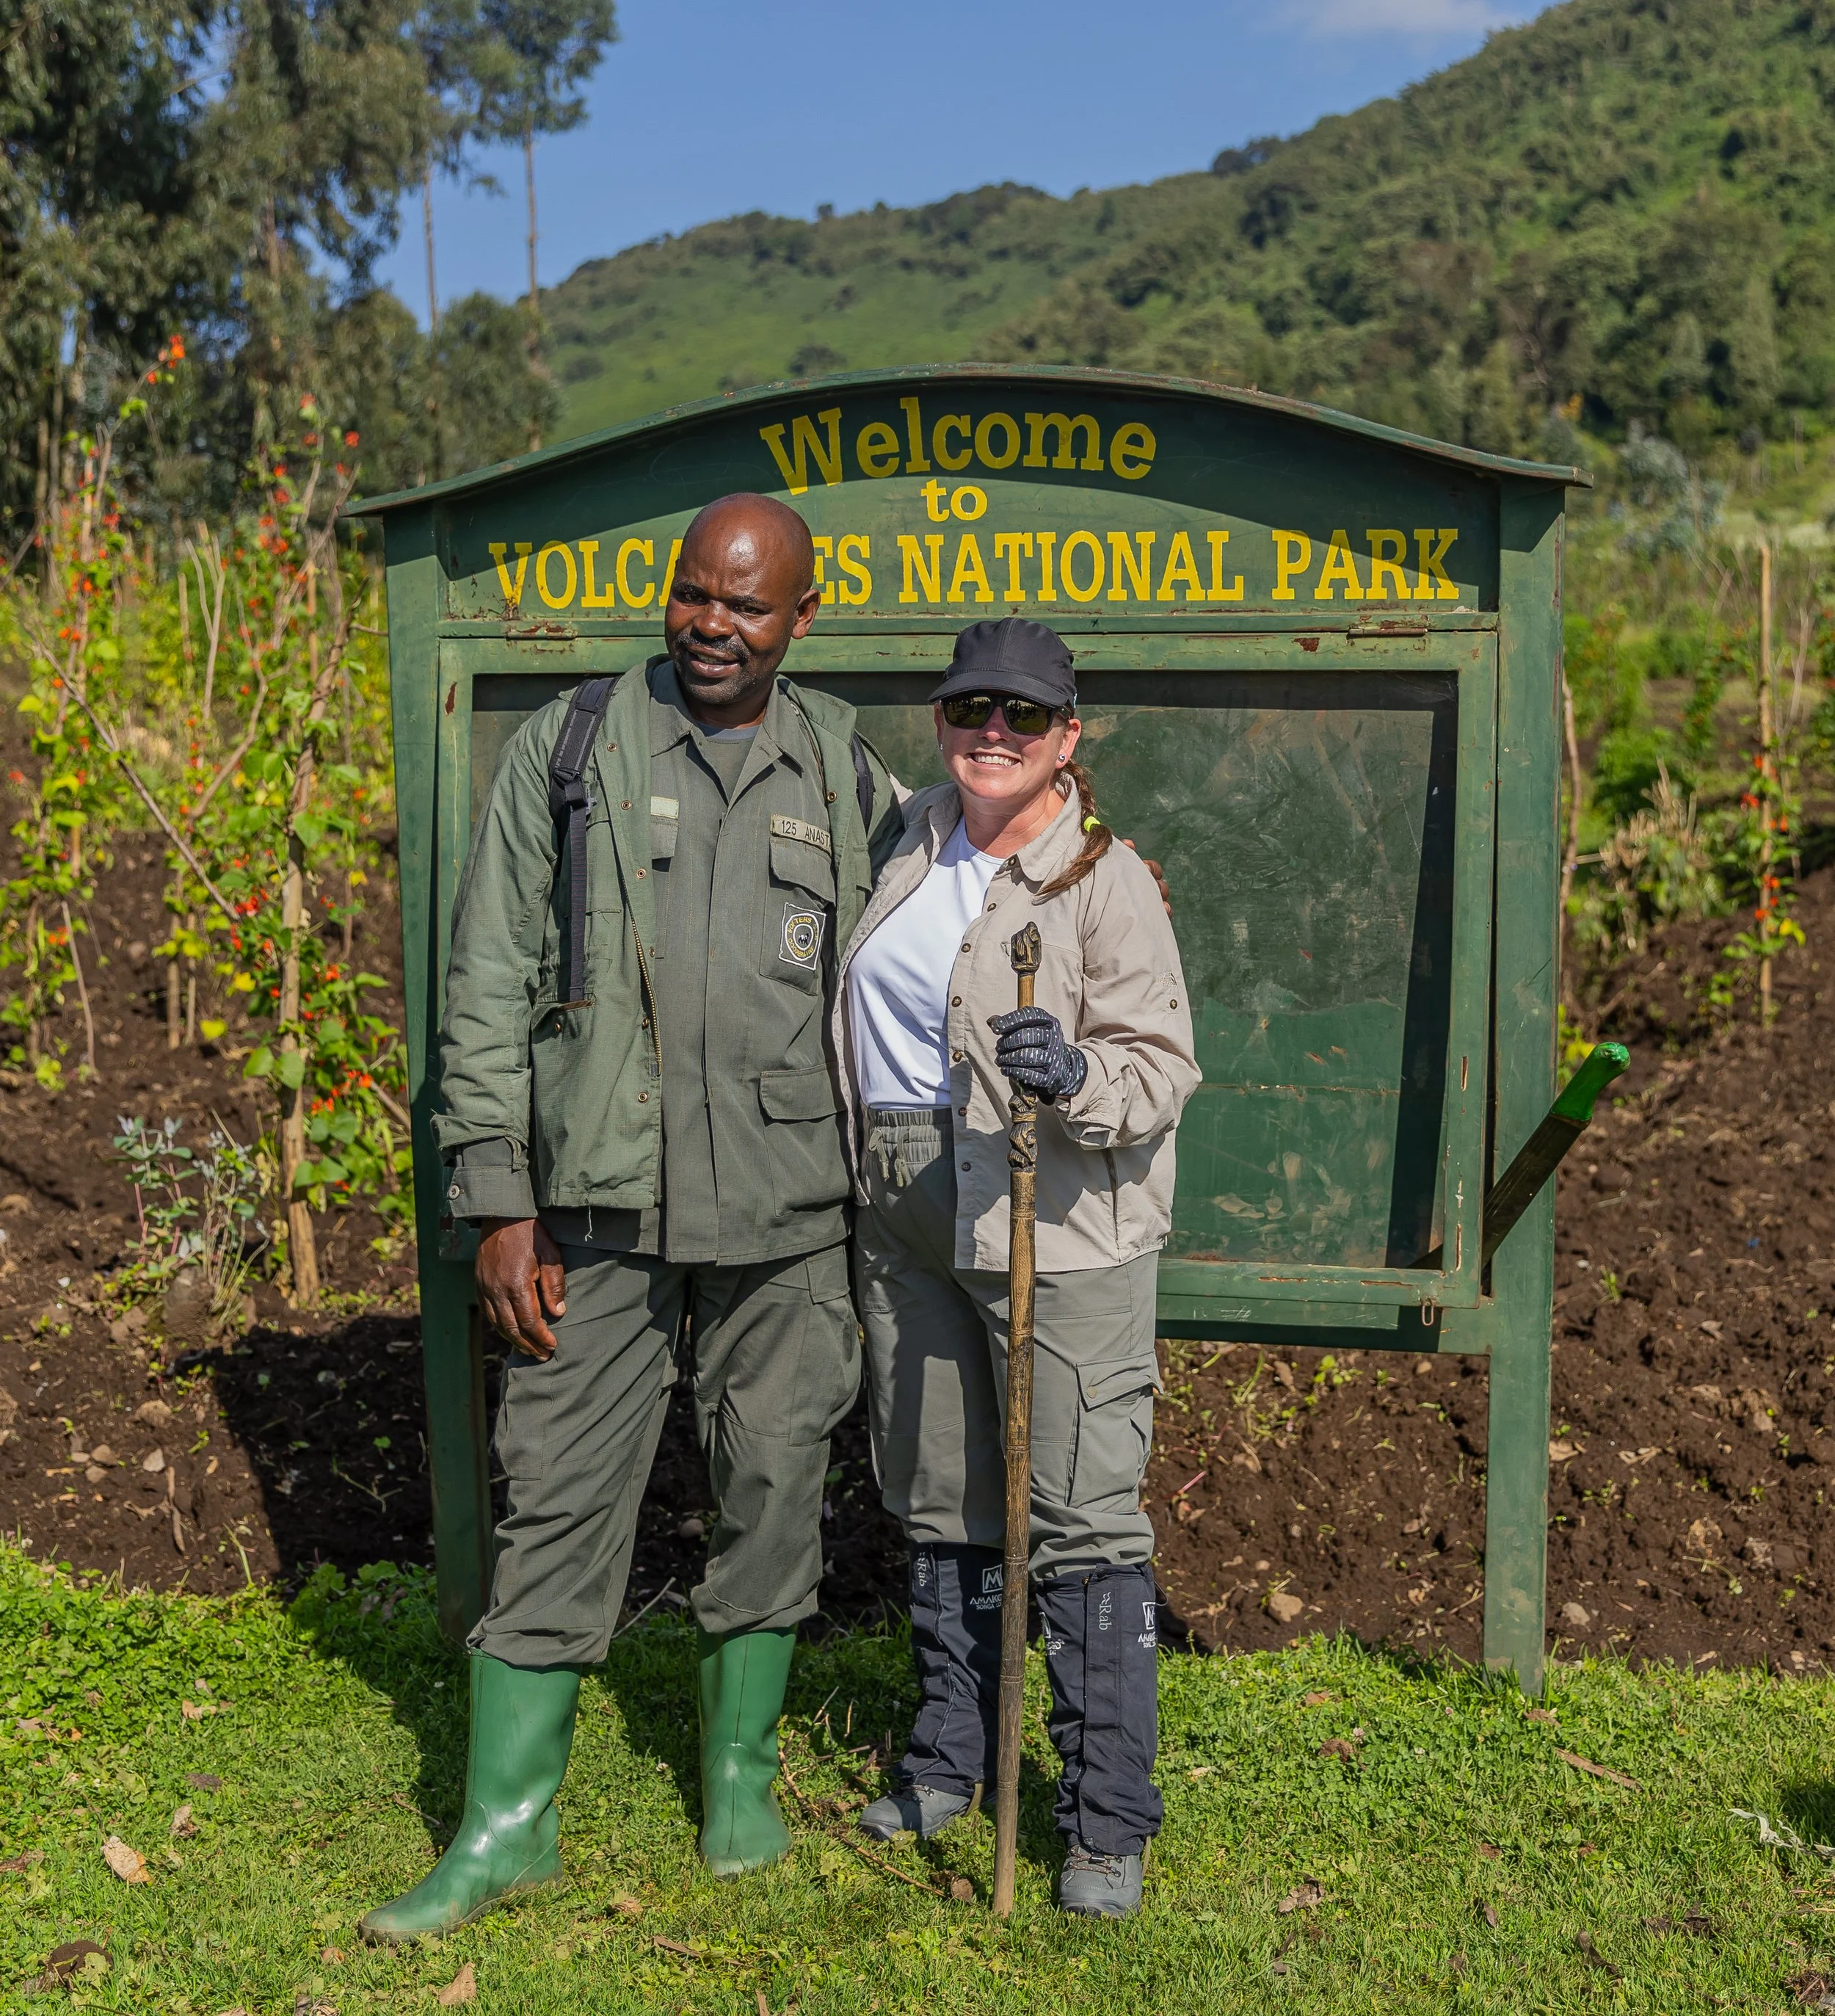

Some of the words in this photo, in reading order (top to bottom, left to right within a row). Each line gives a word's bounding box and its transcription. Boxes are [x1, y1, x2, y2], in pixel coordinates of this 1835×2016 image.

[759, 396, 1156, 496] Welcome
[920, 479, 989, 523] to
[488, 534, 873, 609] VOLCES
[897, 529, 1246, 604] NATIONAL
[1271, 528, 1460, 601] PARK
[782, 819, 797, 836] 125
[804, 825, 830, 847] ANAST
[917, 1562, 927, 1587] Rab
[1098, 1603, 1113, 1631] Rab
